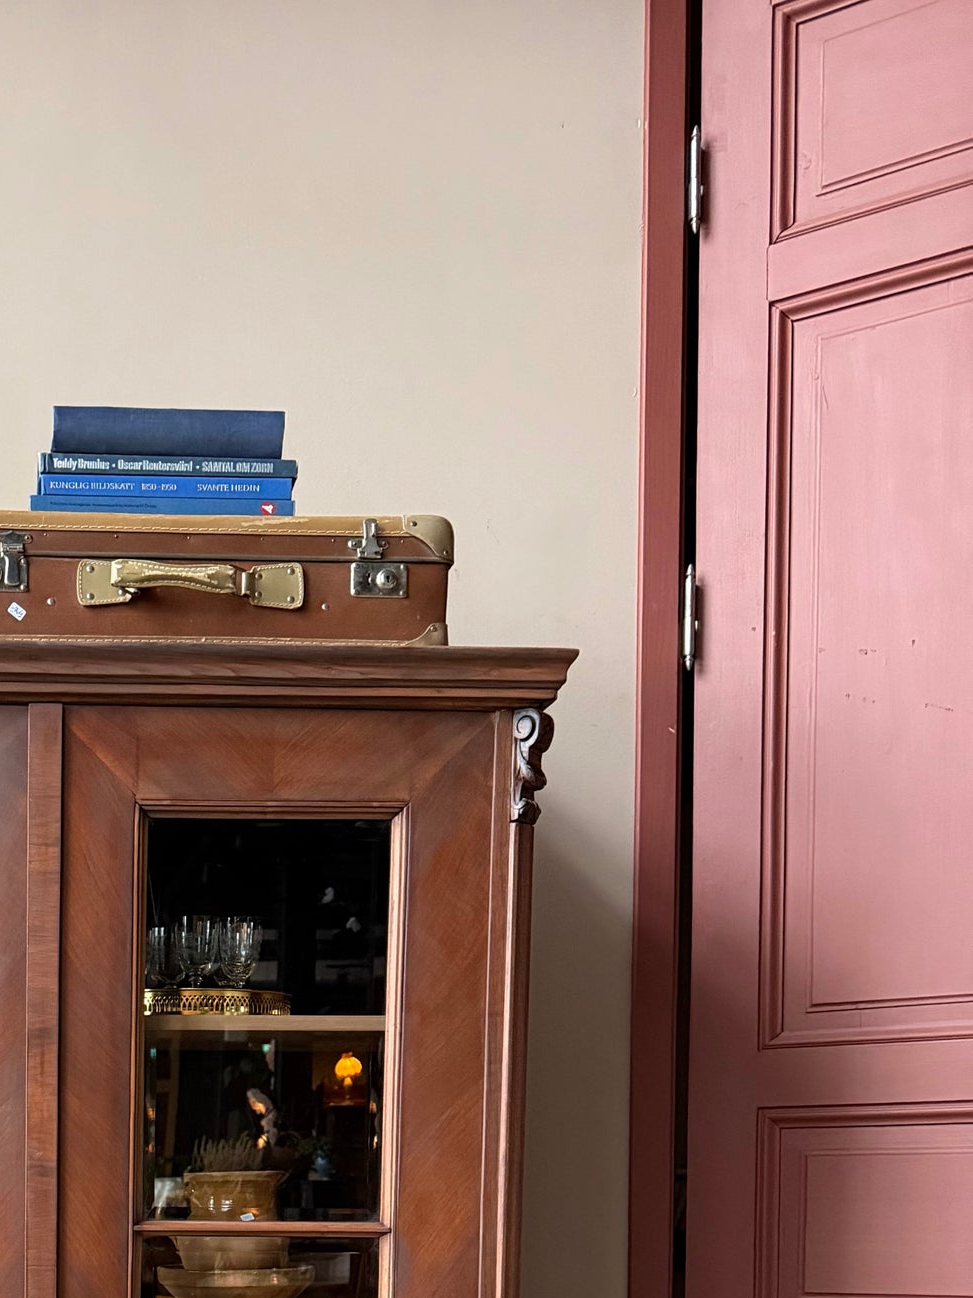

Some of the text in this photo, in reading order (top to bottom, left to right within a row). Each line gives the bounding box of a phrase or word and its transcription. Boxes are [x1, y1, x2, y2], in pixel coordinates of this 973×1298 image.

[52, 457, 274, 474] Teddy Brunius Oscar Reutersvärd SAMTAL OM ZORN
[50, 481, 89, 490] KUNGLIG
[90, 482, 135, 491] BILDSKATT
[197, 484, 229, 492] SVANTE
[230, 484, 260, 492] HEDIN
